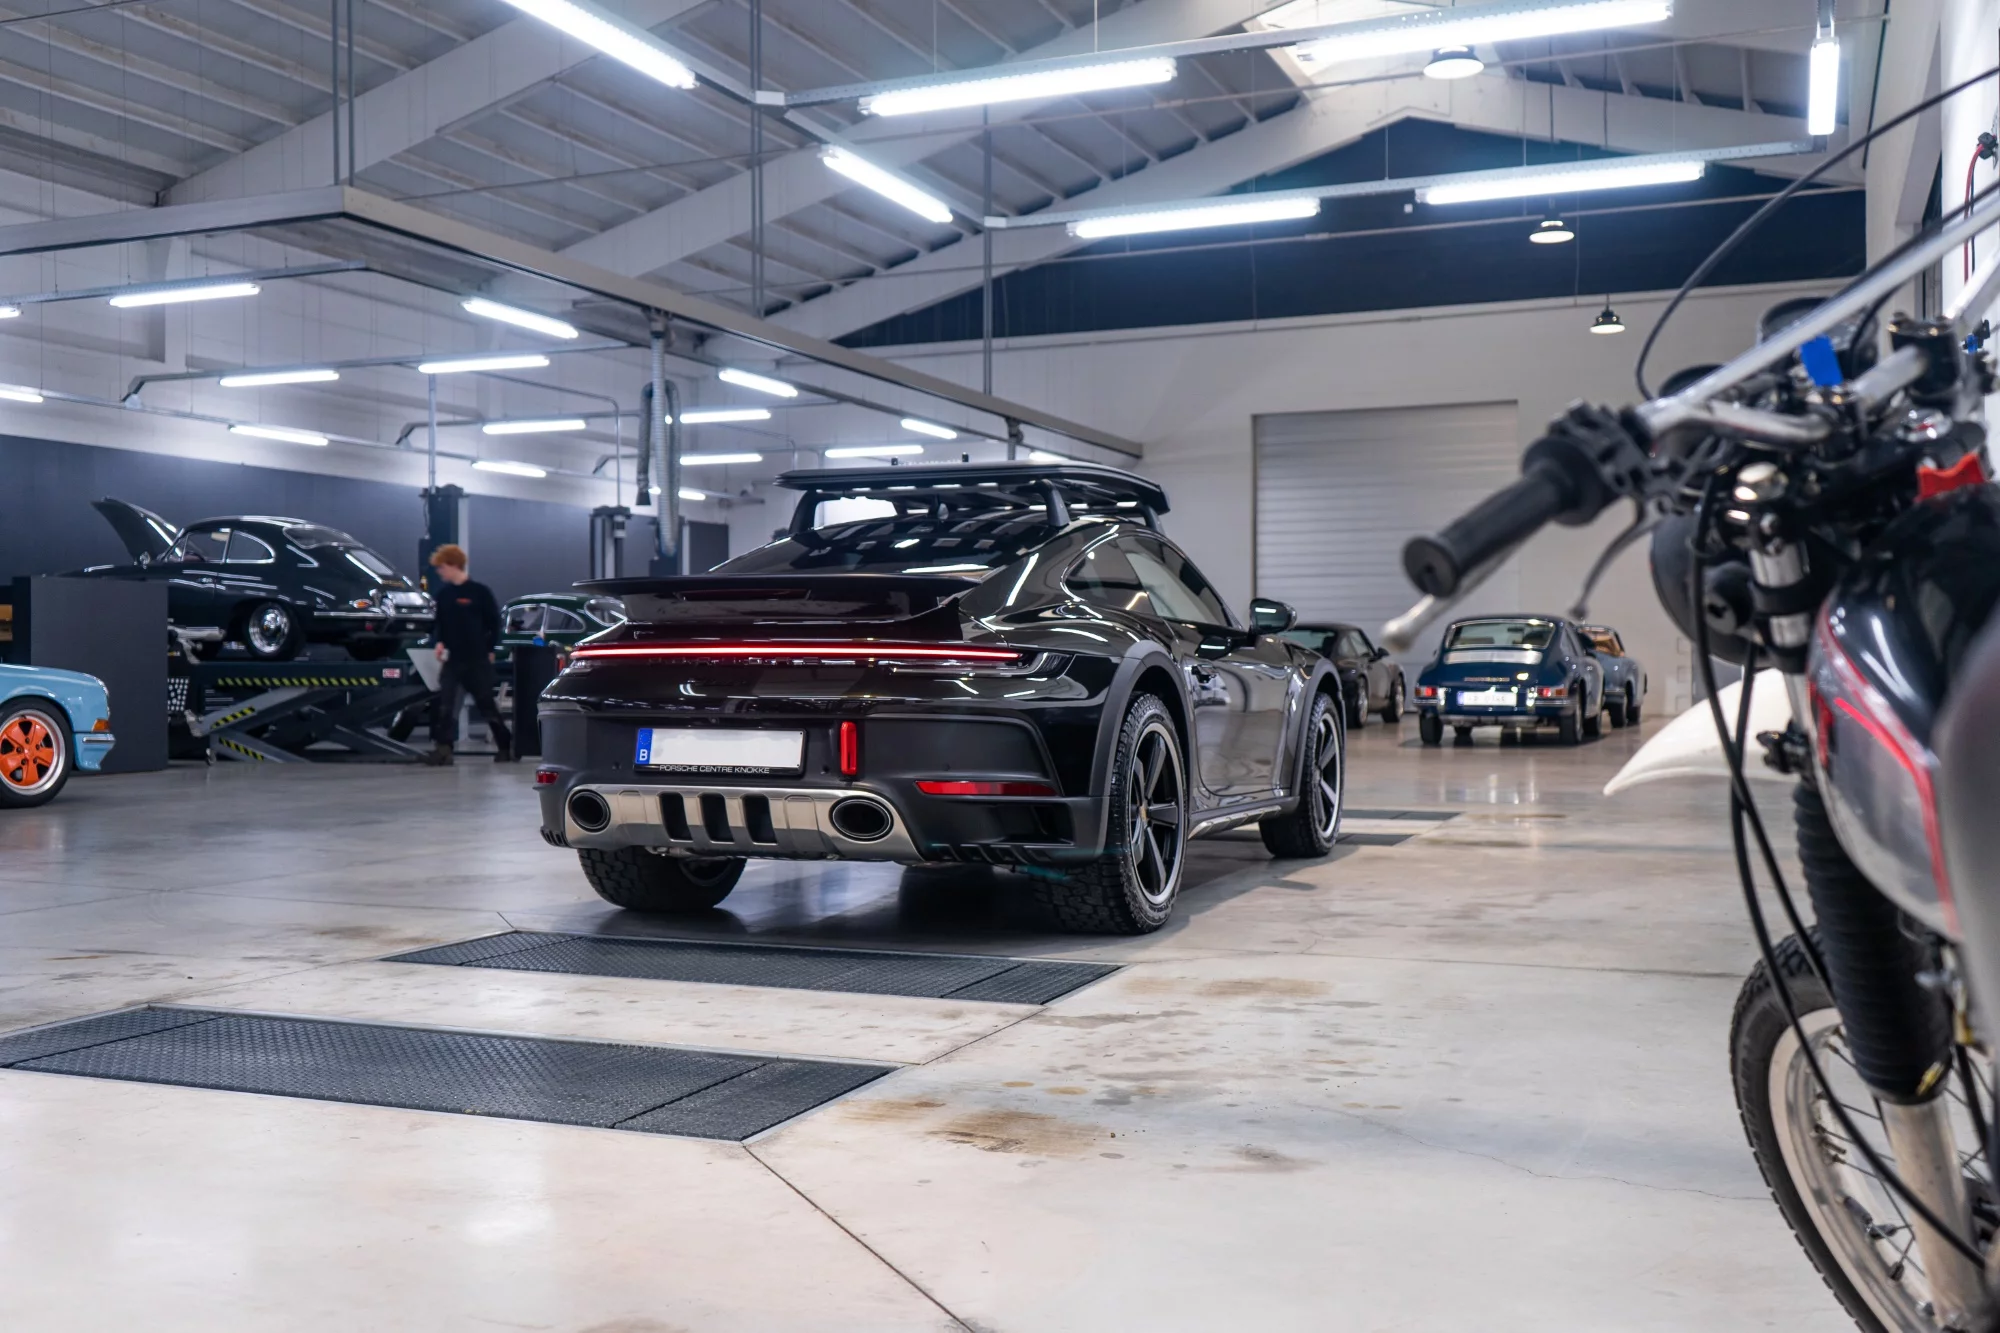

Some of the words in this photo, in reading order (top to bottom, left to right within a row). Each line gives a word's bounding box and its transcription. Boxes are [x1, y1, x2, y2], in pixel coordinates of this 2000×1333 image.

[639, 749, 648, 761] B
[659, 764, 698, 772] PORSCHE
[700, 765, 733, 773] CENTRE
[734, 766, 770, 774] KNOKKE
